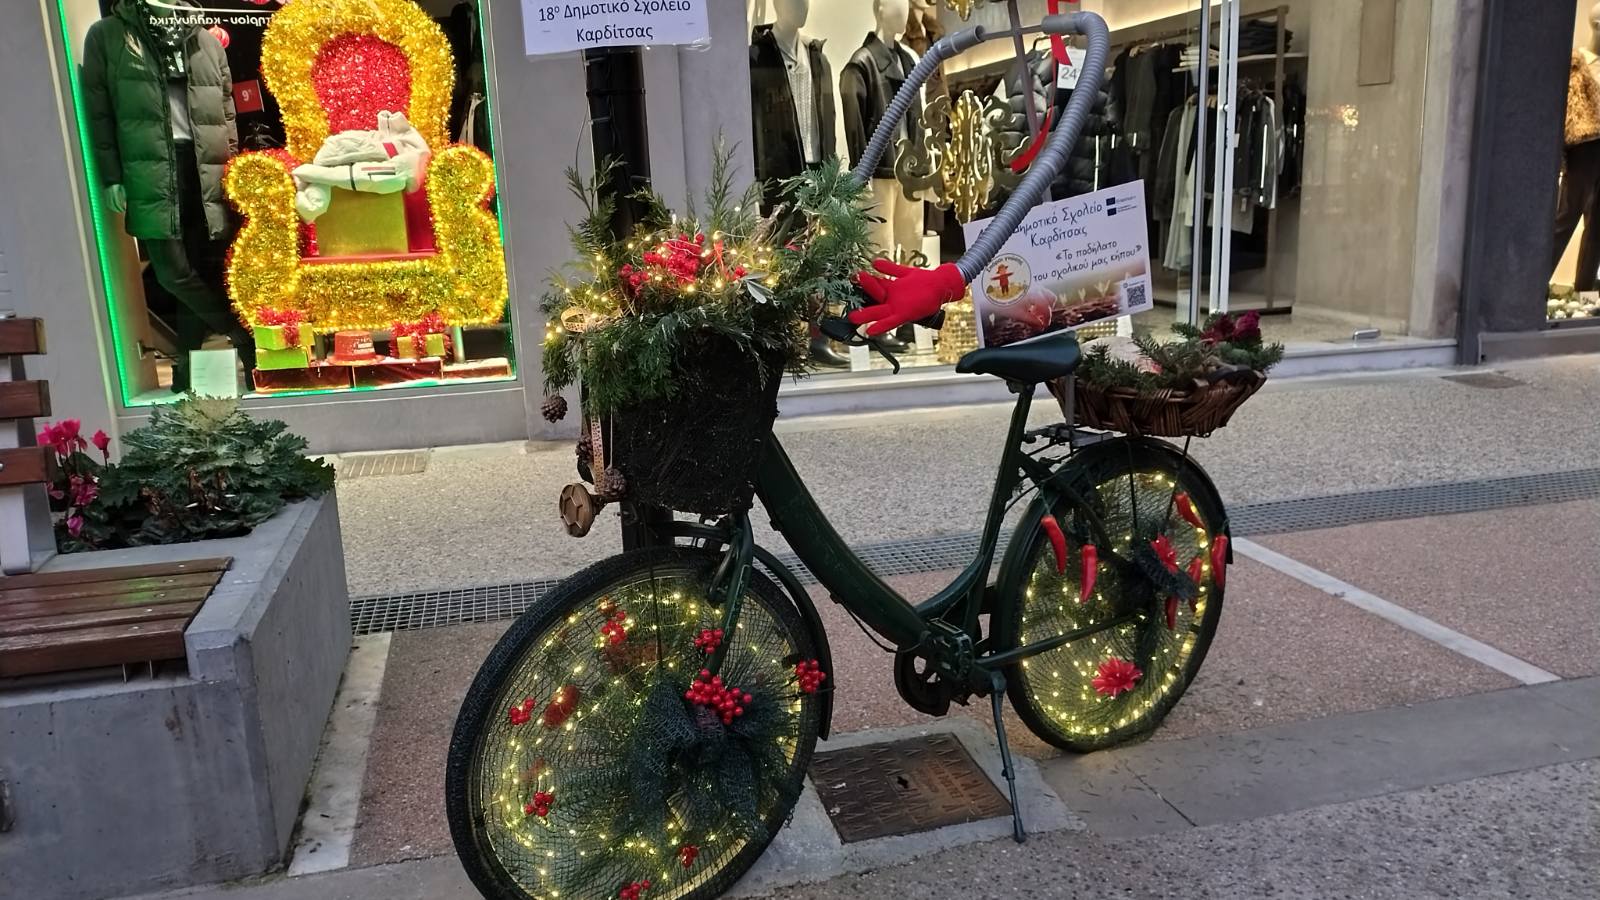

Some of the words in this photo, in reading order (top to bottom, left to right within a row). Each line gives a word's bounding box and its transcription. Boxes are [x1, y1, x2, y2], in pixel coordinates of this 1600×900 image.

[577, 24, 653, 43] Καρδίτσας
[1062, 202, 1103, 224] Σχολείο
[1030, 226, 1088, 248] Καρδίτσας
[1076, 241, 1118, 257] ποδήλατο
[1033, 272, 1048, 281] του
[1051, 259, 1089, 280] σχολικού
[1091, 257, 1109, 270] μας
